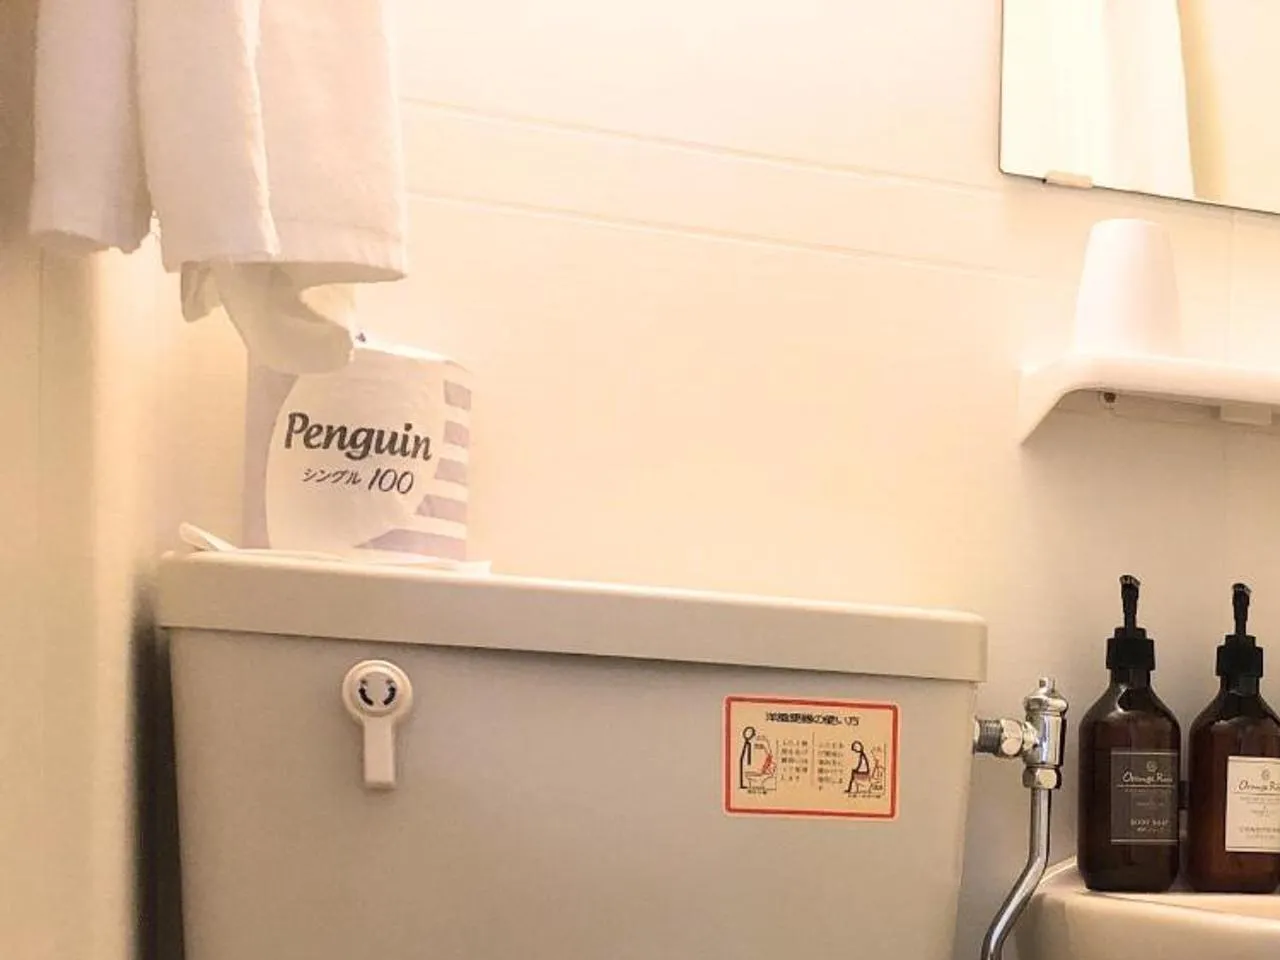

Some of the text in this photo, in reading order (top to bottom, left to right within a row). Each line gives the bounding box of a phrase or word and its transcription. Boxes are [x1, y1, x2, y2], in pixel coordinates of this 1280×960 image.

[284, 411, 432, 461] Penguin
[301, 467, 414, 494] シングル 100
